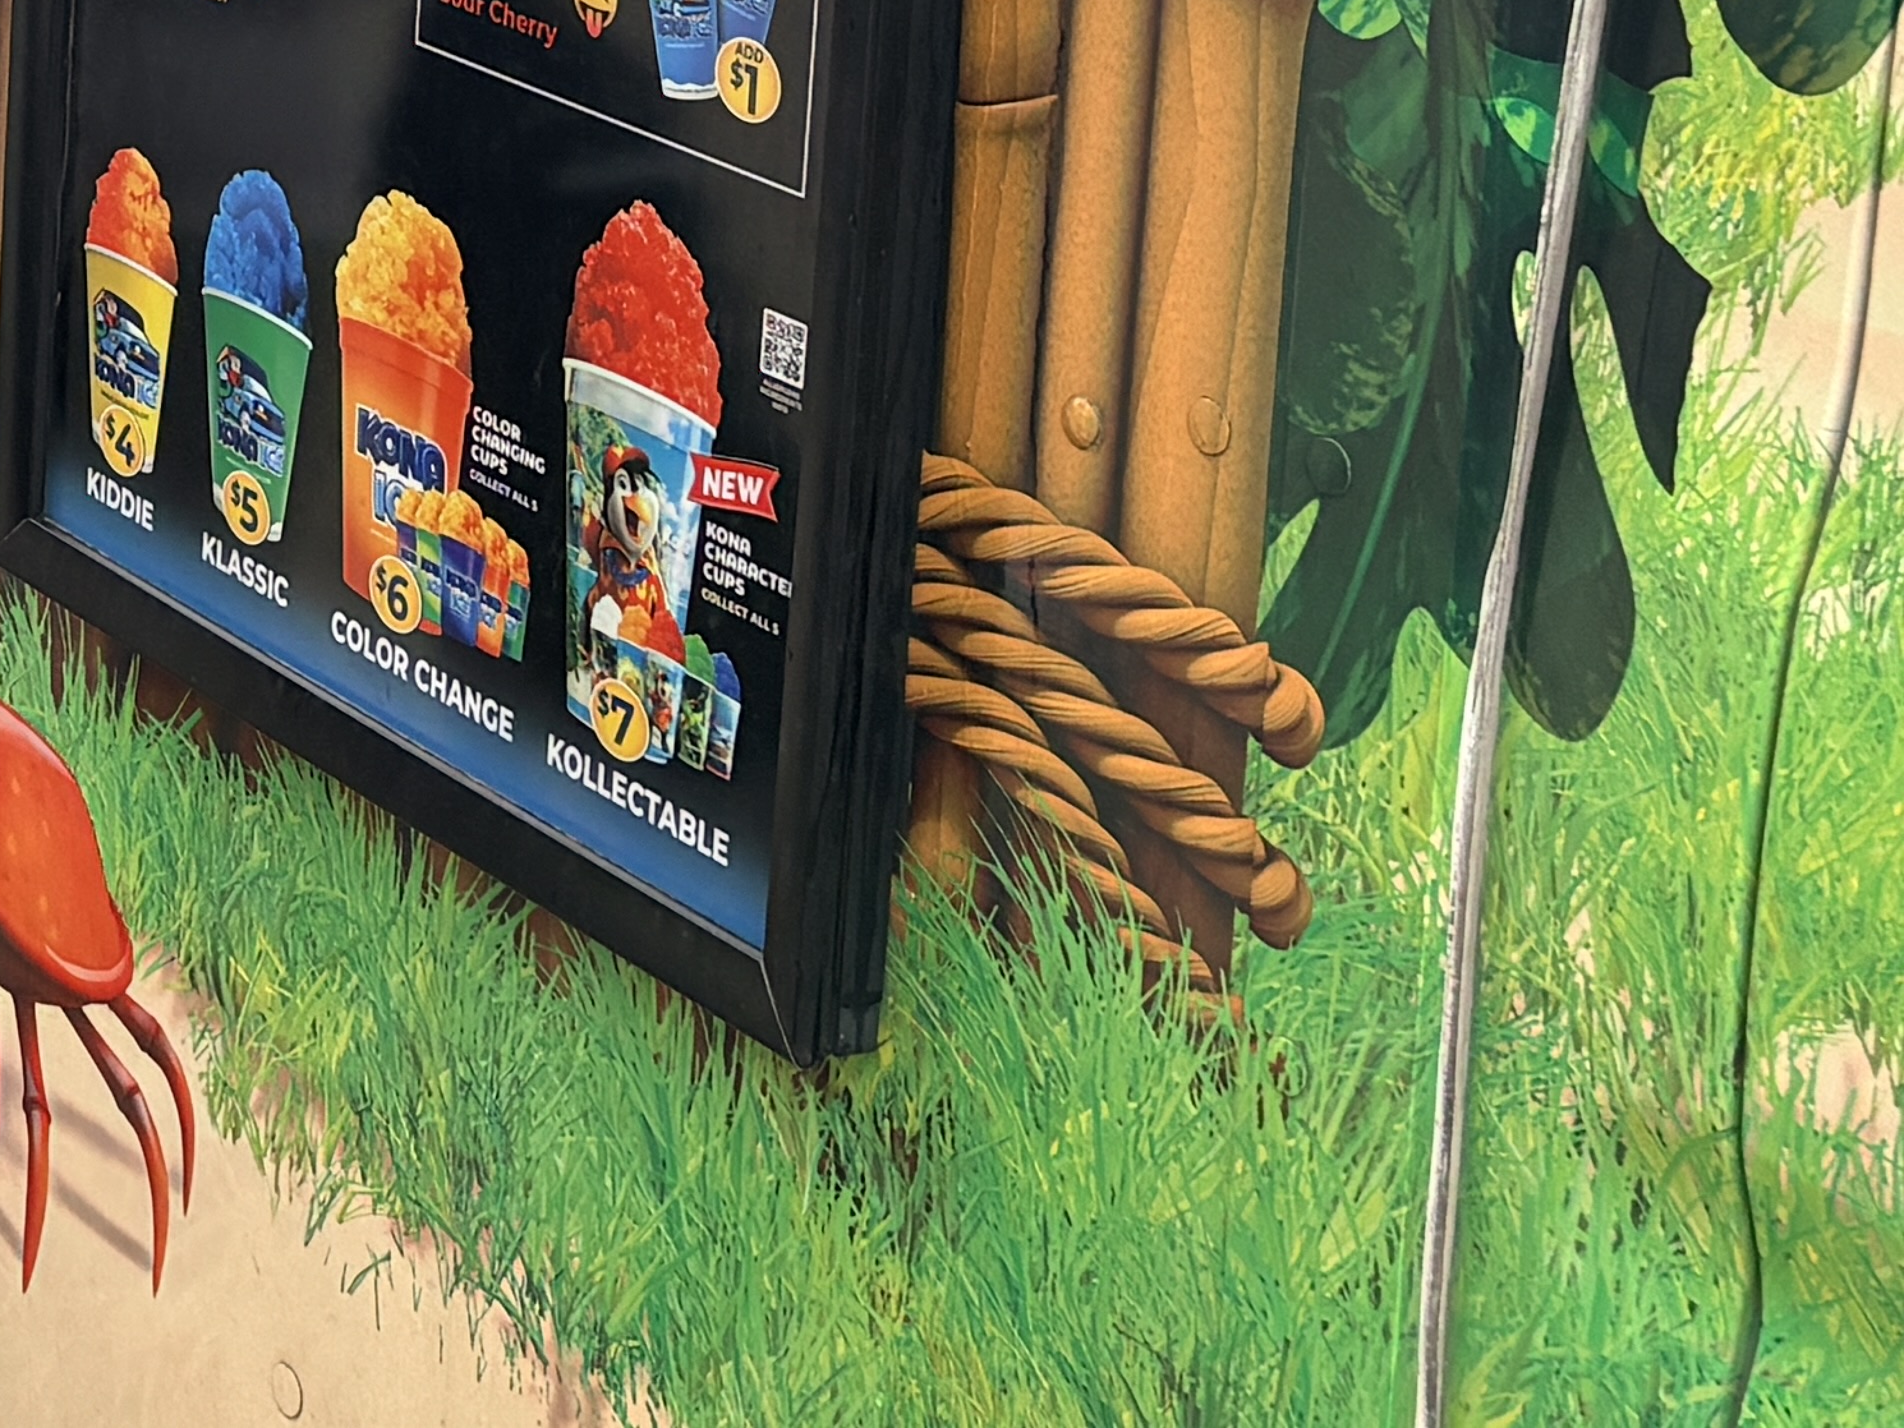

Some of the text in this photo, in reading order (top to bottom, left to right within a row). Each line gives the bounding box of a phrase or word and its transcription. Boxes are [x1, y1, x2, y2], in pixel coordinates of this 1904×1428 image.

[488, 0, 558, 49] Cherry
[735, 42, 764, 64] ADD
[730, 58, 758, 116] $1
[105, 413, 135, 468] $4
[355, 403, 448, 494] KONA
[472, 406, 522, 443] COLOR
[470, 444, 508, 476] CUPS
[472, 426, 546, 475] CHANGING
[86, 466, 154, 532] KIDDIE
[230, 479, 259, 533] $5
[469, 468, 511, 498] COLLECT
[512, 489, 530, 510] ALL
[703, 466, 763, 505] NEW
[705, 521, 751, 557] KONA
[200, 531, 289, 608] KLASSIC
[375, 564, 409, 622] $6
[703, 563, 745, 597] CUPS
[700, 587, 748, 621] COLLECT
[750, 613, 769, 633] ALL
[330, 611, 515, 743] COLOR CHANGE
[597, 688, 634, 744] $7
[546, 733, 731, 867] KOLLECTABLE
